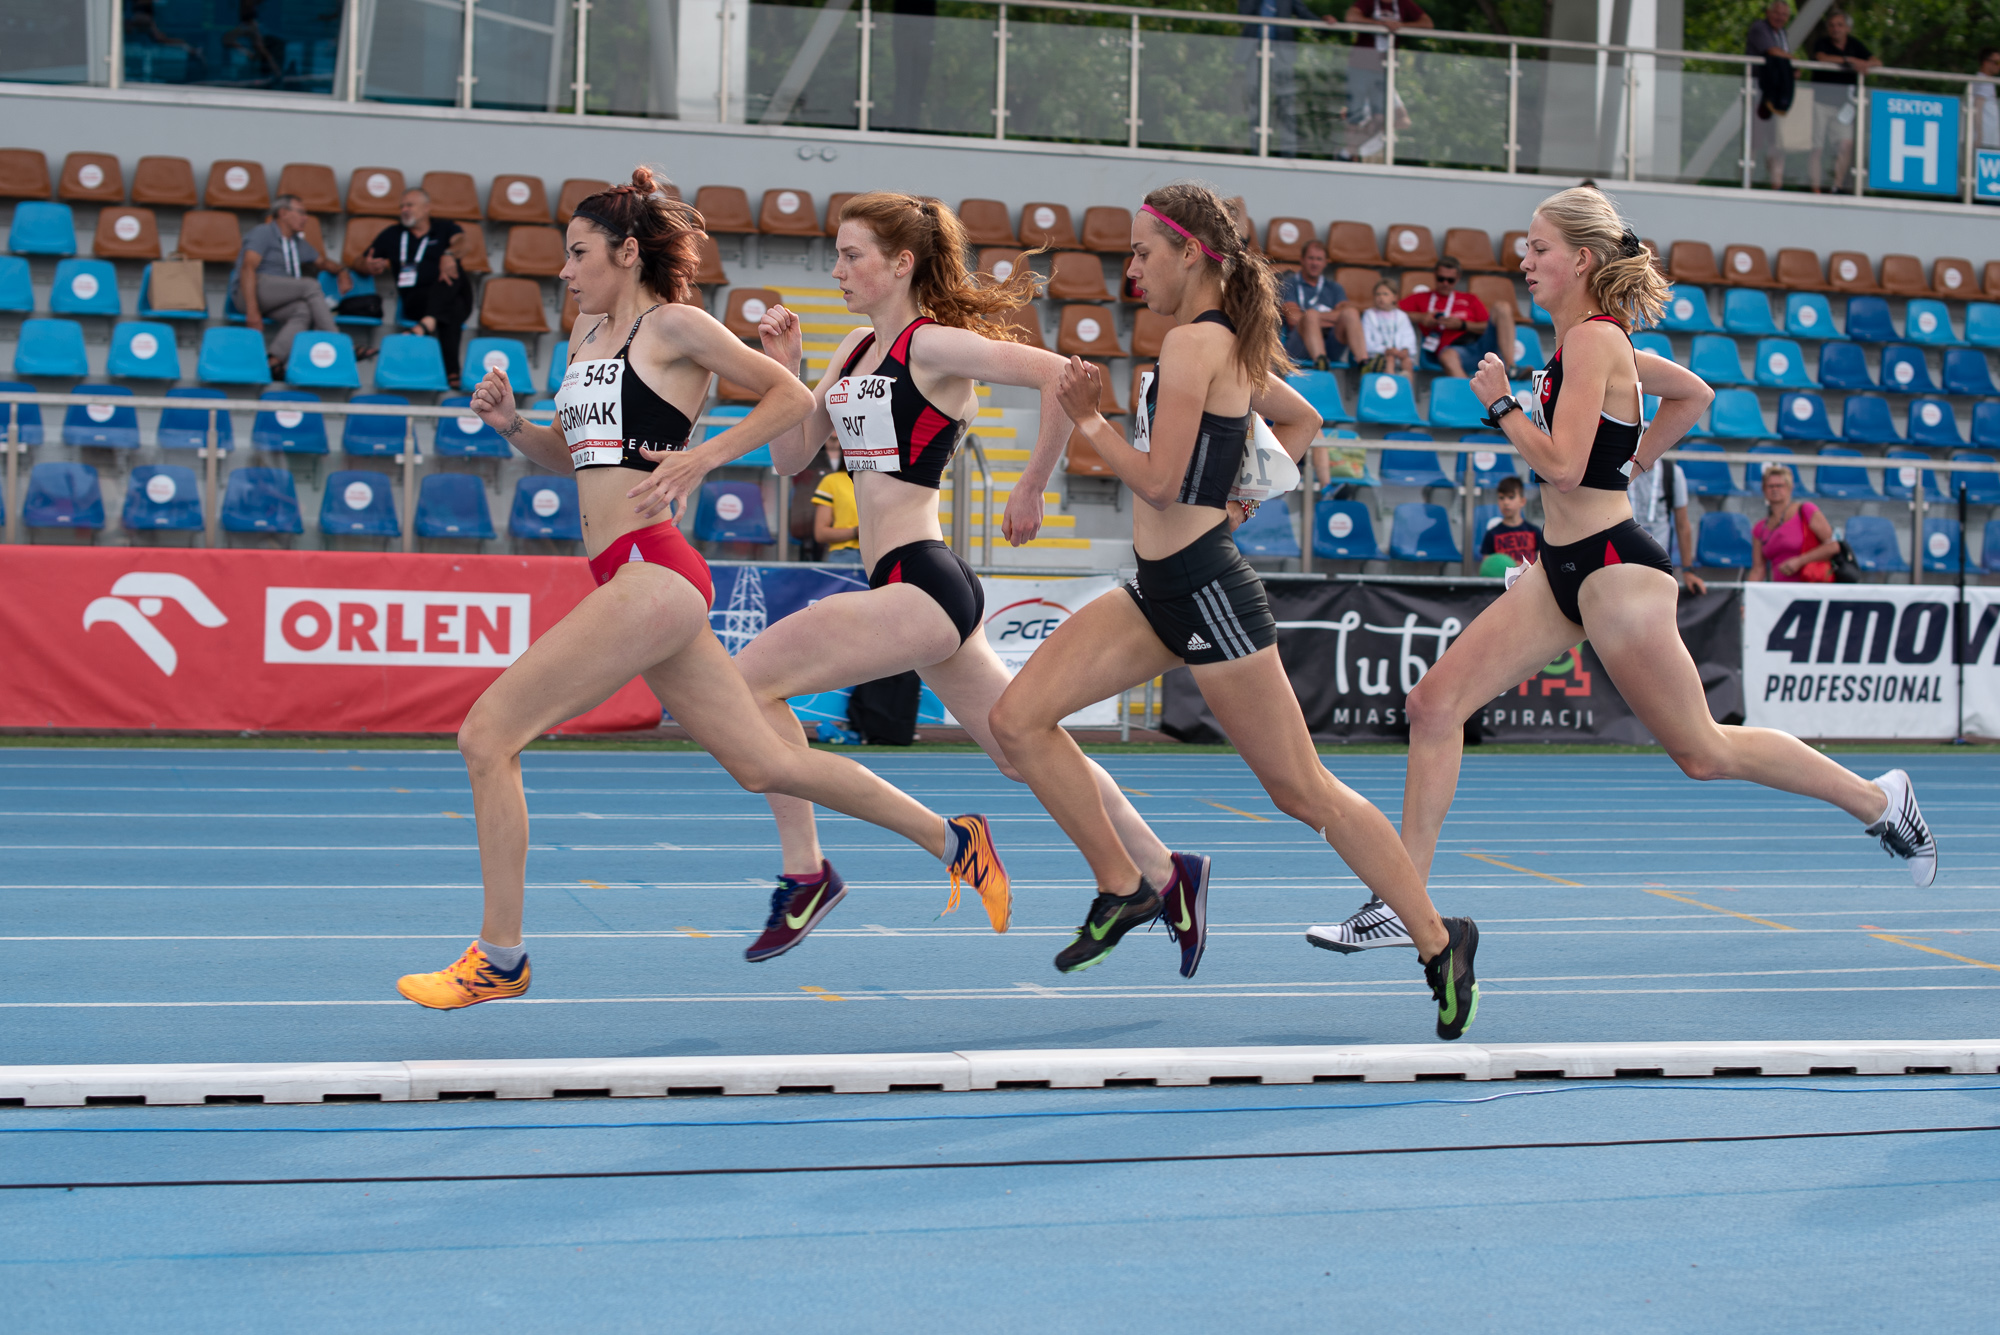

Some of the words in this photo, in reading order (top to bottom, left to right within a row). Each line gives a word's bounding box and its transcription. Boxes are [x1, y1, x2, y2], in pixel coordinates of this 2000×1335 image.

[1887, 97, 1943, 117] SEKTOR
[1889, 117, 1939, 185] H
[583, 363, 619, 388] 543
[831, 394, 848, 403] ORLEN
[857, 378, 886, 400] 348
[558, 402, 617, 432] GÓRNIAK
[842, 415, 866, 437] PUT
[861, 460, 877, 470] 2021
[1497, 534, 1529, 550] NEW
[280, 599, 512, 655] ORLEN
[999, 618, 1061, 641] PGE
[1186, 641, 1212, 651] adidas
[1763, 674, 1943, 703] PROFESSIONAL
[1333, 707, 1411, 725] MIAST
[1482, 708, 1594, 730] SPIRACJI
